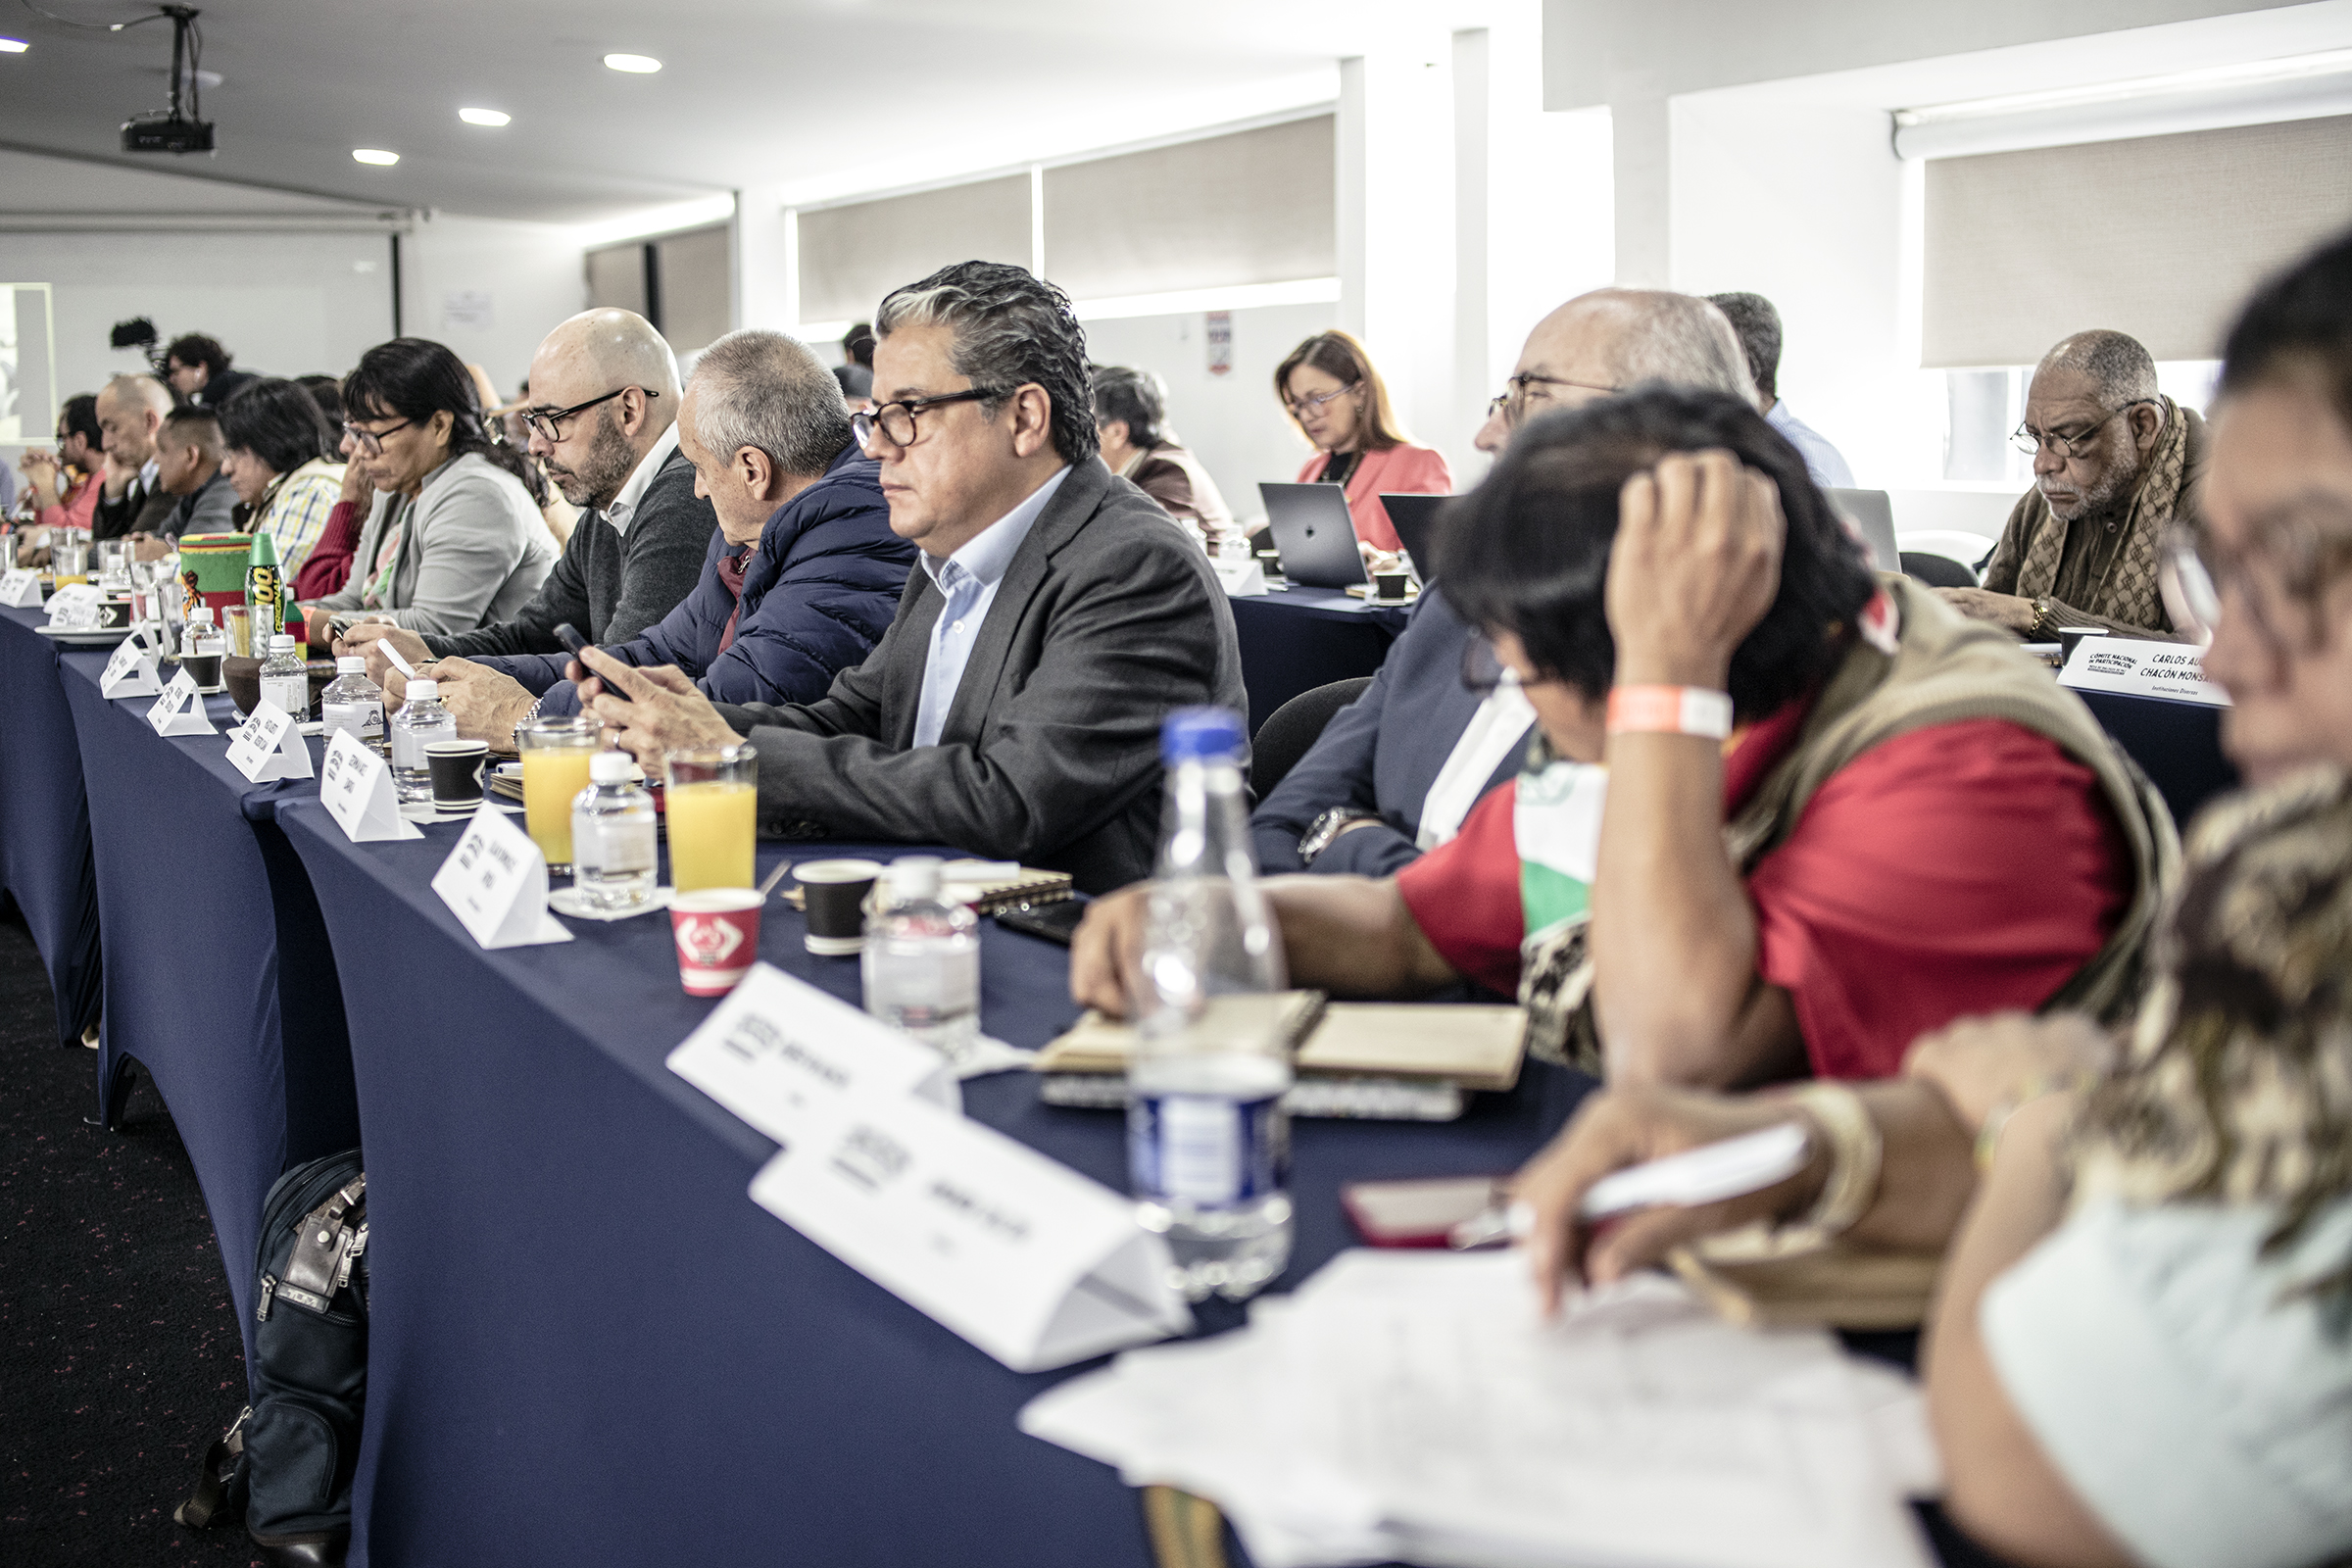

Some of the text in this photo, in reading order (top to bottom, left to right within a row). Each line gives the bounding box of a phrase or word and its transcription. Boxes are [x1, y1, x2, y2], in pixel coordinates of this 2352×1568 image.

[2112, 655, 2137, 664] NACIONAL
[2152, 654, 2186, 665] CARLOS
[2140, 667, 2177, 679] CHACÓN
